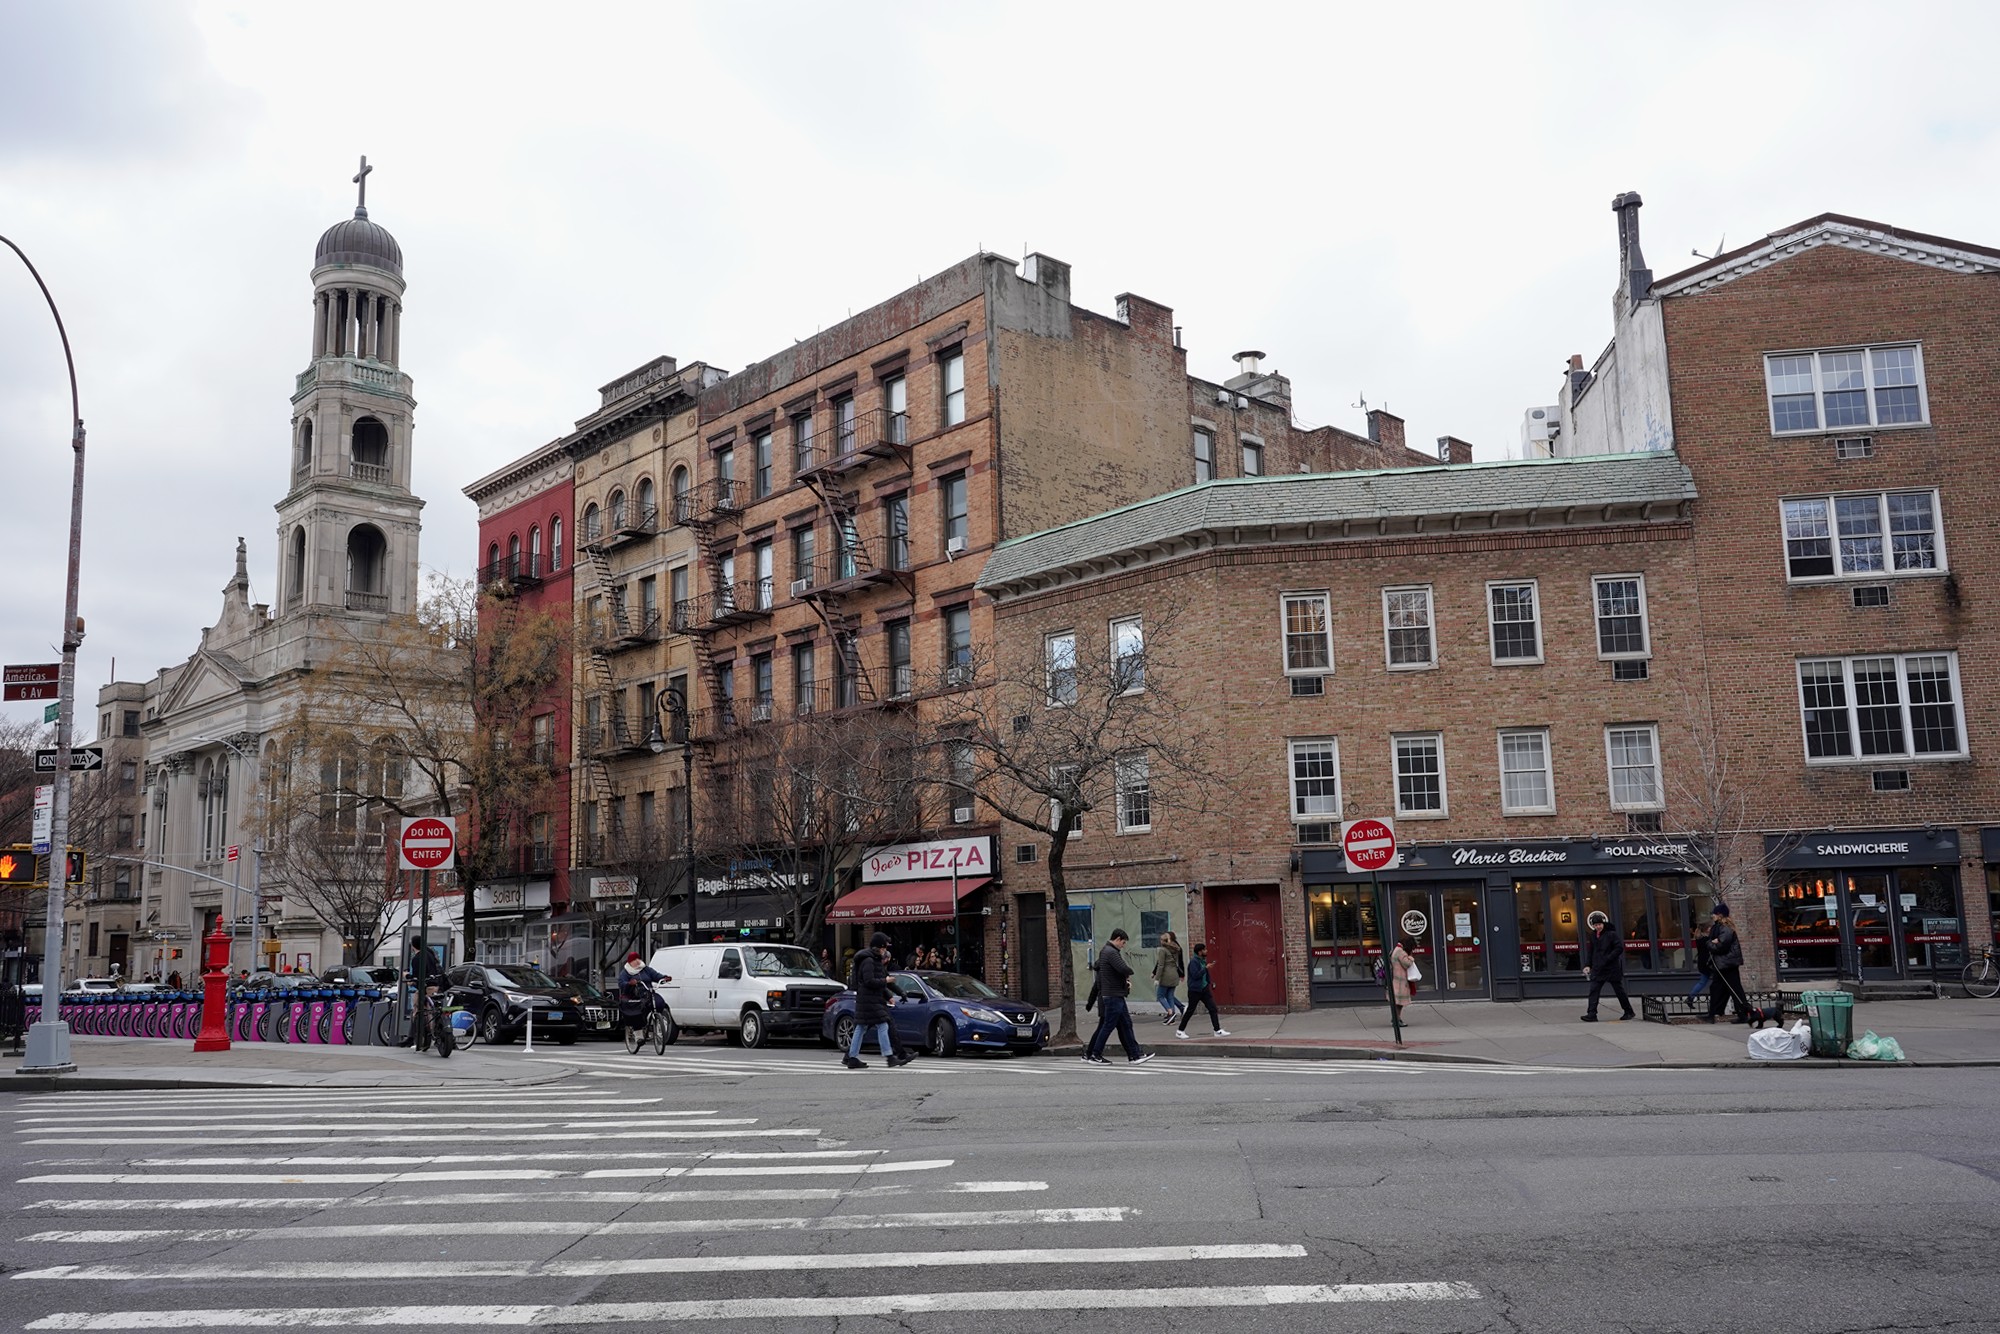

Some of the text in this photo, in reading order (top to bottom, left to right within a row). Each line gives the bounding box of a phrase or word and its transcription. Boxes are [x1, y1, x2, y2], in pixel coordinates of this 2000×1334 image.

[5, 673, 46, 682] Americas
[20, 687, 42, 698] 6 Av
[41, 755, 94, 766] ON WAY
[411, 827, 445, 837] DO NOT
[1351, 827, 1384, 840] DO NOT
[412, 850, 442, 859] ENTER
[1605, 844, 1689, 857] BOULANGERIE
[1816, 842, 1909, 856] SANDWICHERIE
[871, 845, 985, 877] Joe's PIZZA
[1357, 850, 1387, 862] ENTER
[1451, 847, 1567, 866] Marie Blachère
[881, 905, 904, 917] JOE'S
[906, 904, 932, 916] PIZZA
